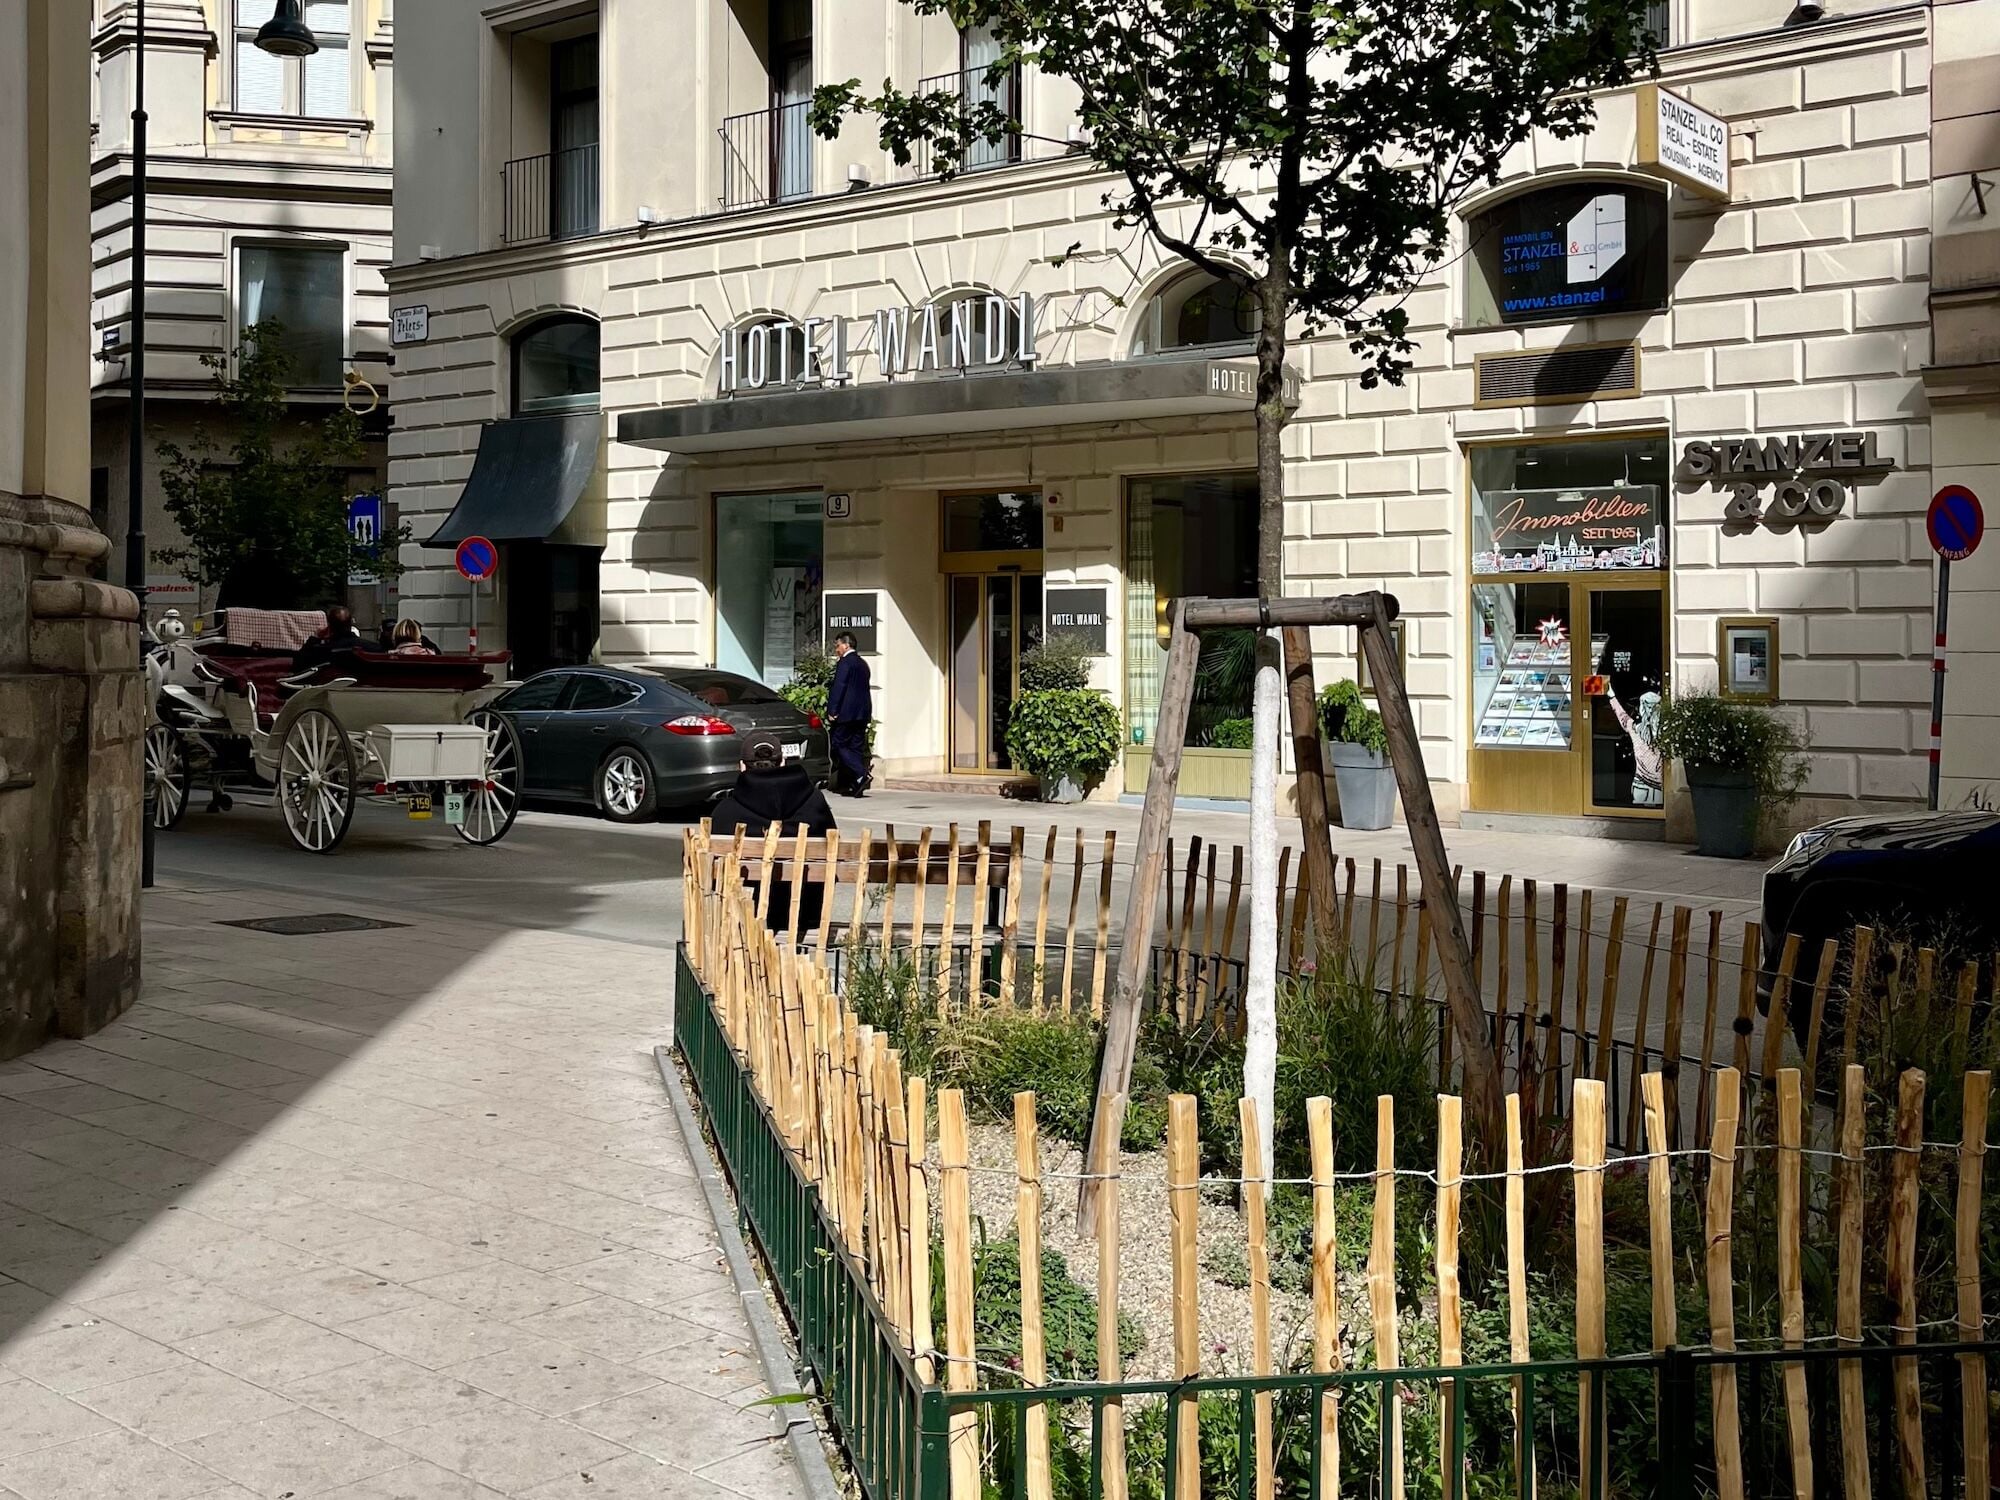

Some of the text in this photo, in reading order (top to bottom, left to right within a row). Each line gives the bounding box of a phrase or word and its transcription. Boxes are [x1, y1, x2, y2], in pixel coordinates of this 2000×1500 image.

[1661, 98, 1723, 145] STANZEL u. CO
[1666, 125, 1685, 148] REAL
[1693, 138, 1718, 163] ESTATE
[1661, 144, 1691, 169] HOUSING
[1698, 162, 1723, 184] AGENCY
[1503, 231, 1553, 244] IMMOBILIEN
[1503, 242, 1566, 263] STANZEL
[1569, 241, 1580, 254] &
[1597, 240, 1623, 251] GmbH
[1503, 261, 1541, 275] seit 1965
[1503, 286, 1624, 312] www.stanzel
[720, 291, 1041, 392] HOTEL WANDL
[1211, 367, 1254, 394] HOTEL
[1683, 431, 1896, 477] STANZEL
[834, 496, 842, 511] 9
[1732, 478, 1846, 519] & CO
[1490, 494, 1653, 542] Immobilien
[1582, 526, 1637, 540] SEIT 1965
[1938, 545, 1971, 560] ANFANG
[768, 577, 792, 601] W
[829, 615, 873, 628] HOTEL WANDL
[1051, 613, 1102, 626] HOTEL WANDL
[410, 797, 430, 810] F159
[448, 801, 460, 811] 39
